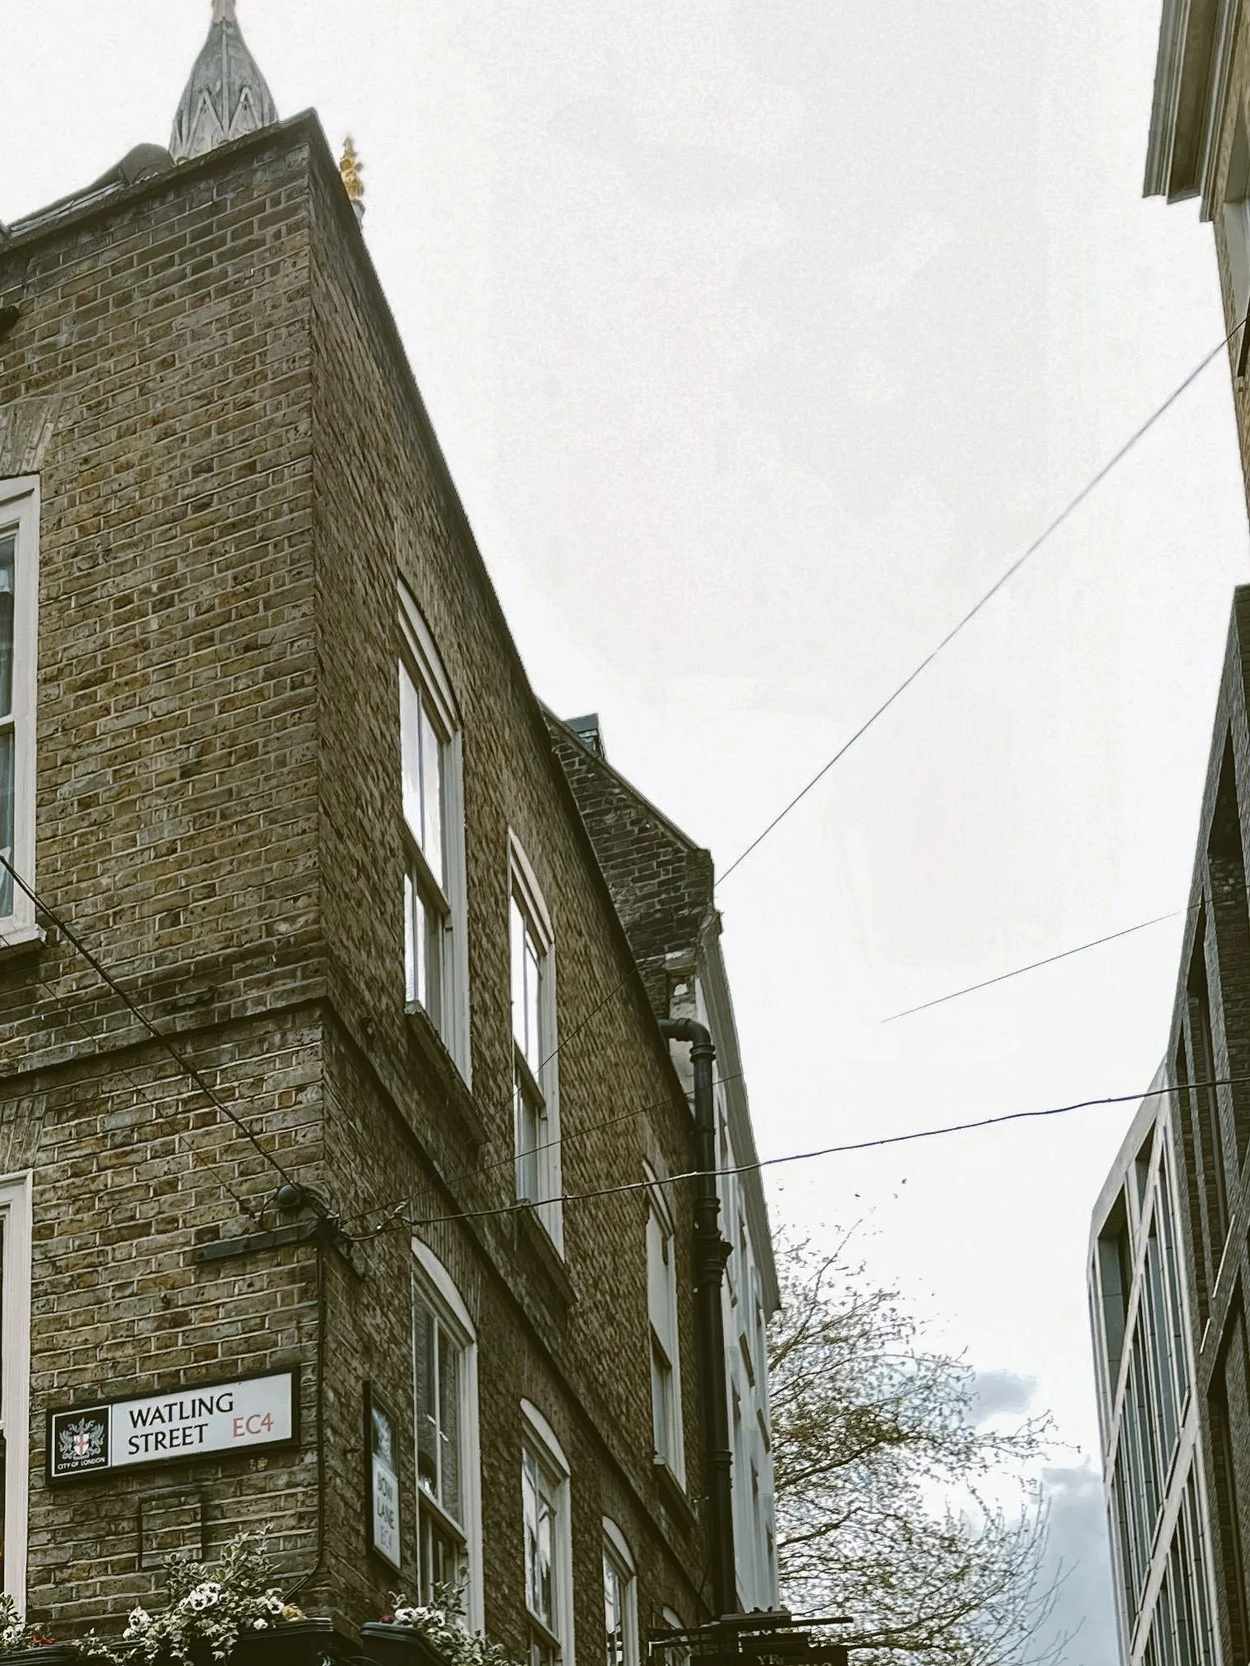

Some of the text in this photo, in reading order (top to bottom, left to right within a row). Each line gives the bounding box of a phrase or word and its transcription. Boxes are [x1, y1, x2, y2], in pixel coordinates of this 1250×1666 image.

[129, 1392, 234, 1429] WATLING
[128, 1423, 209, 1455] STREET
[232, 1413, 274, 1437] EC4
[57, 1462, 71, 1470] CITY
[80, 1457, 105, 1467] LONDON
